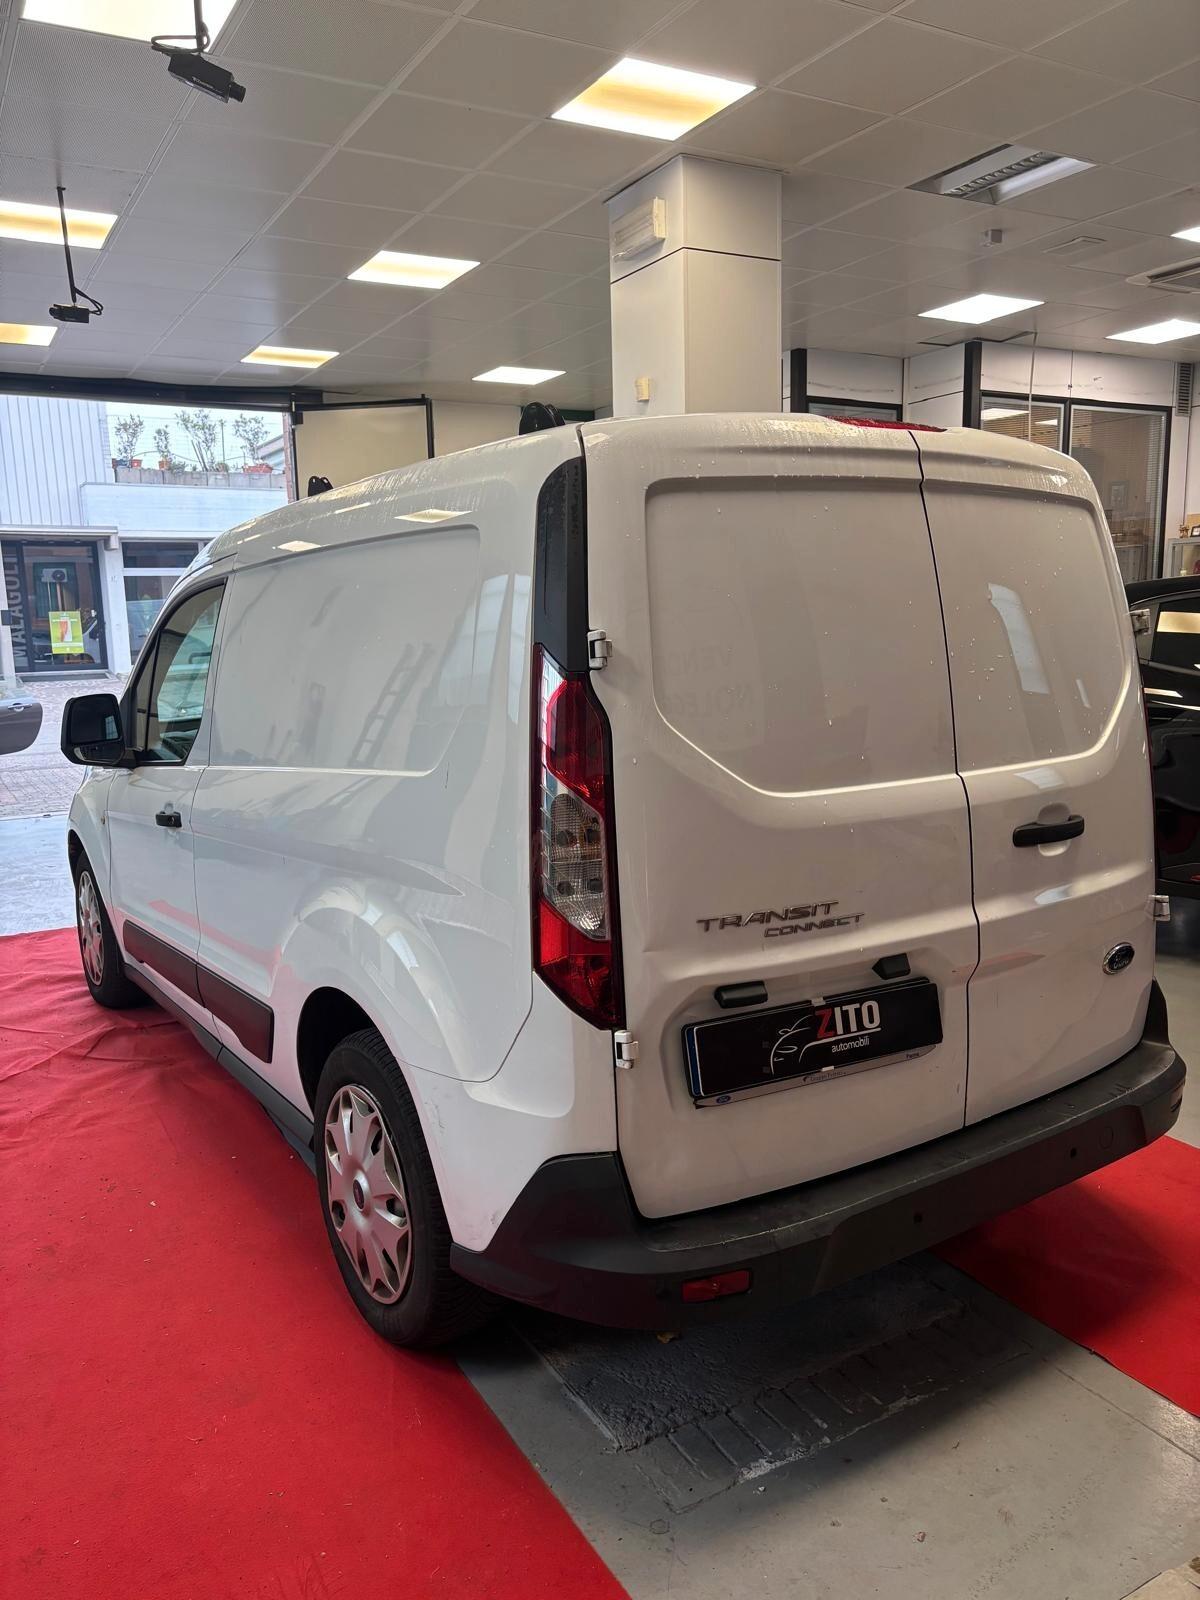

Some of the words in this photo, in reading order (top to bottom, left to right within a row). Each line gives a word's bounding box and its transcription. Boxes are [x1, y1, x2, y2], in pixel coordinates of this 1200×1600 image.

[696, 900, 839, 932] TRANSIT
[764, 913, 865, 937] CONNECT
[815, 1000, 881, 1039] ZITO
[831, 1035, 870, 1053] automobili
